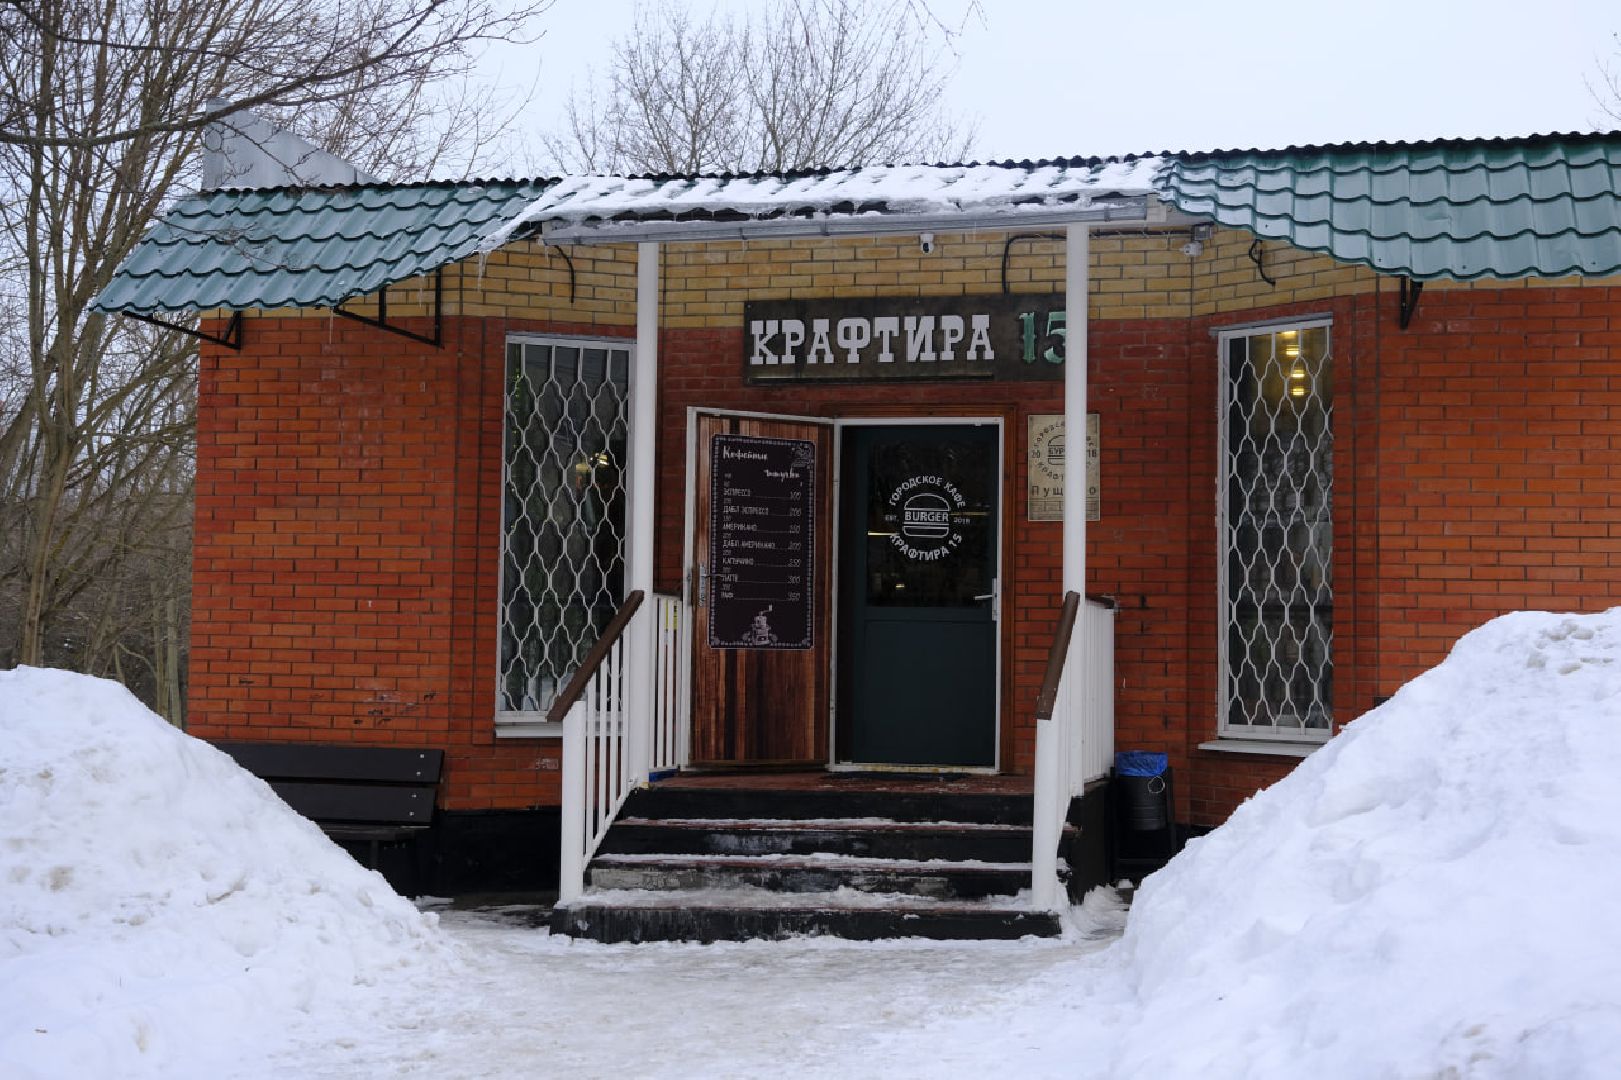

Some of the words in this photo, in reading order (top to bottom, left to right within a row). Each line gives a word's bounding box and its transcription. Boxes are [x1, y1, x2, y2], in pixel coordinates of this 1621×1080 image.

[750, 314, 995, 365] КРАФТИРА
[1017, 311, 1067, 364] 15
[889, 475, 943, 506] ГОРОДСКОЕ
[944, 482, 966, 508] КАФЕ
[1031, 485, 1097, 497] Пущо
[904, 511, 949, 522] BURGER
[889, 535, 950, 560] КРАФТИРА
[949, 533, 962, 547] 15
